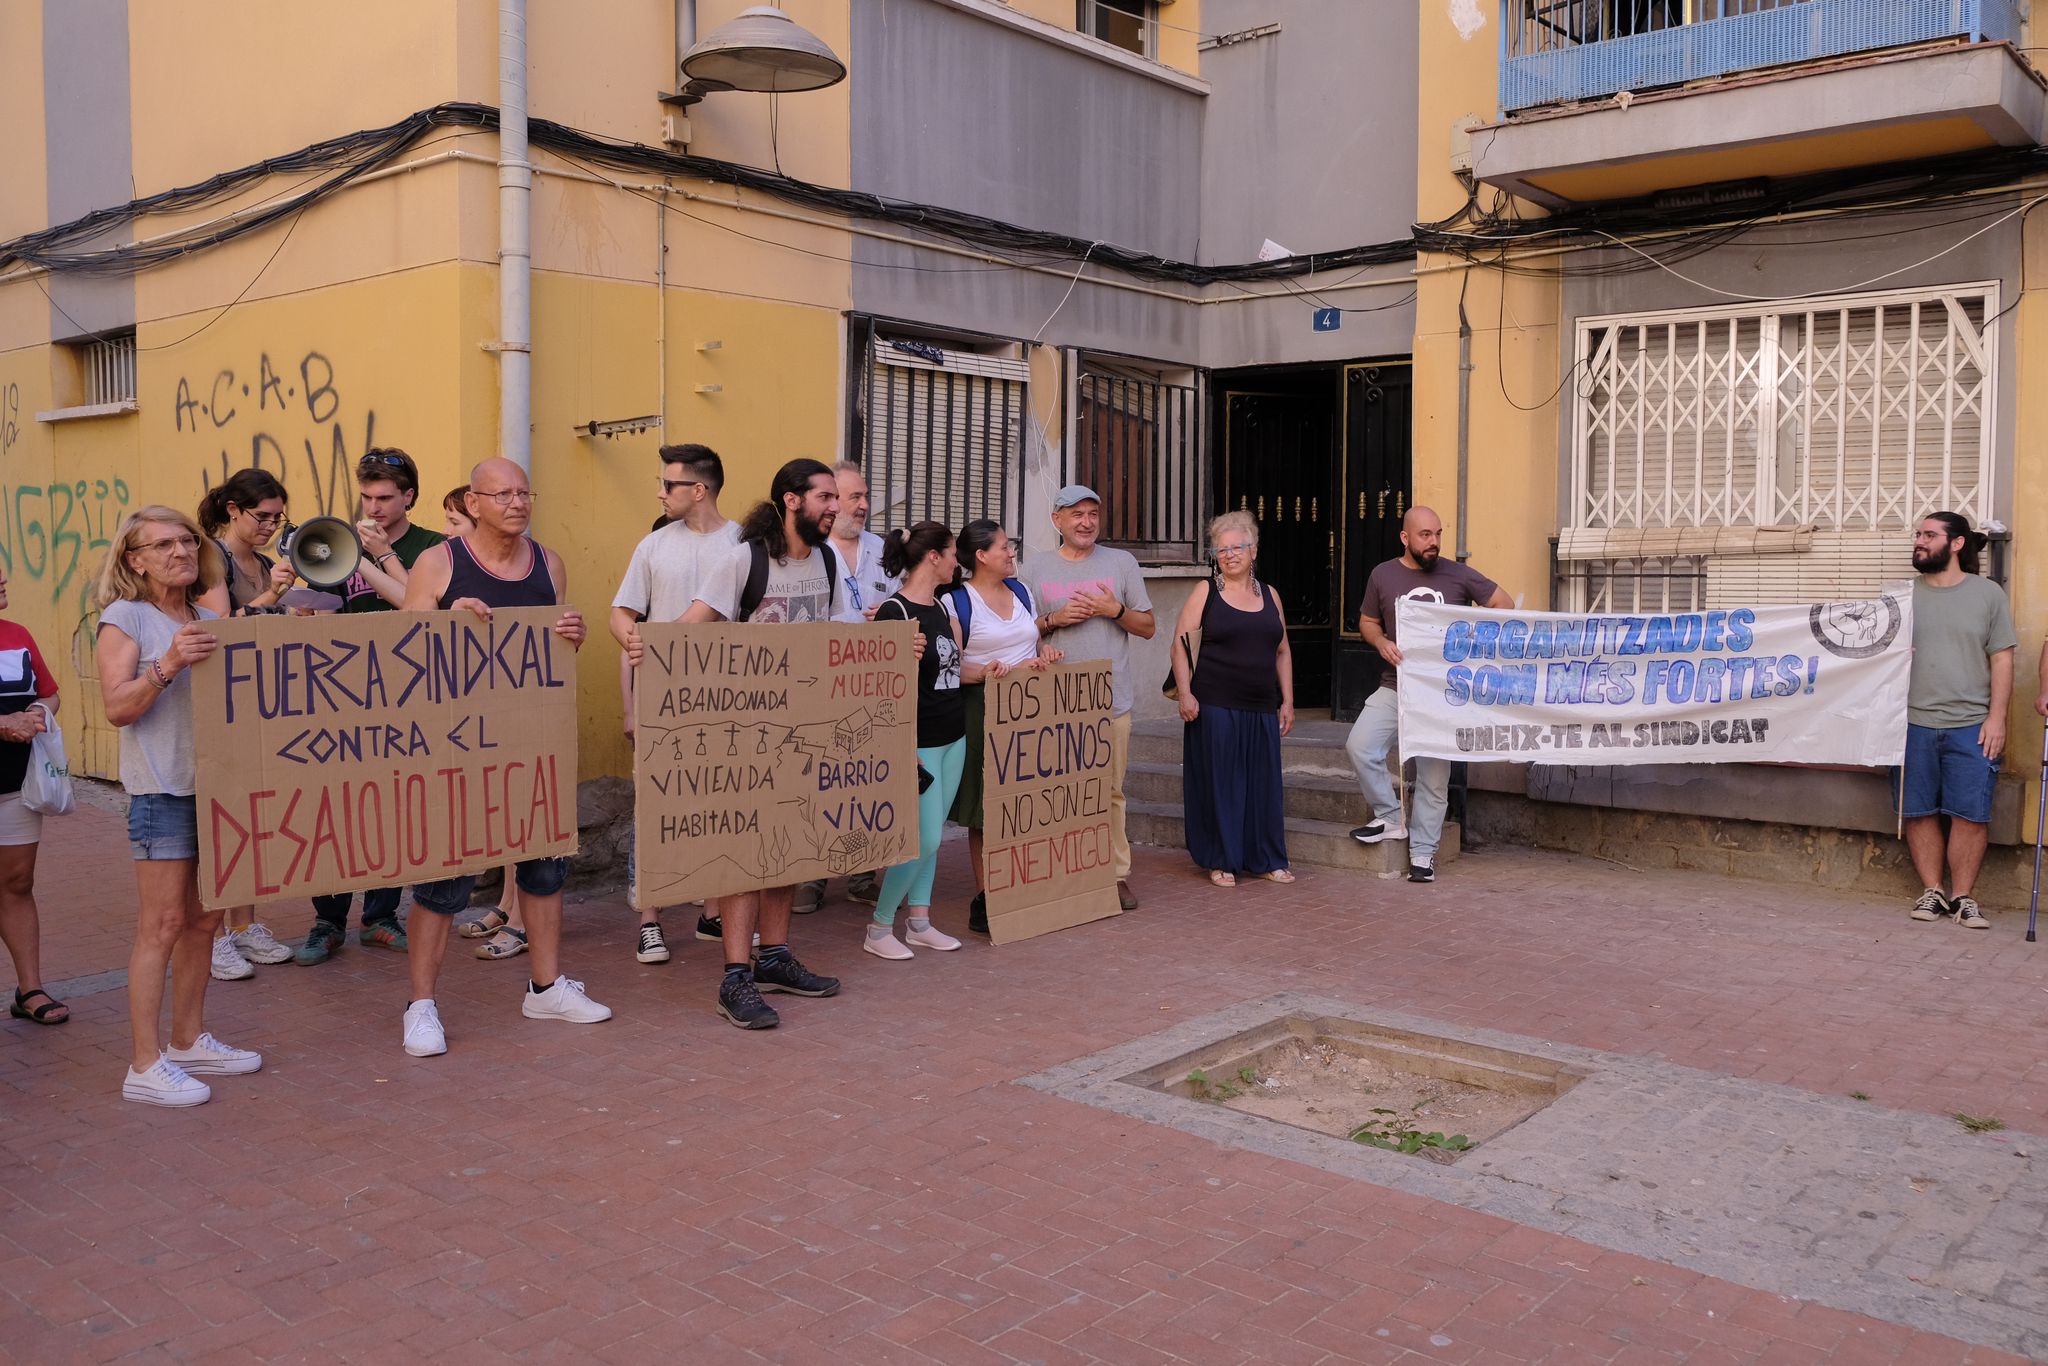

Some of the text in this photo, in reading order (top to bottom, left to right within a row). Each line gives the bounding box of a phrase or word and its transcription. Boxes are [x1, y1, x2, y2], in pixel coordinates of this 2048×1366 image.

[1322, 311, 1331, 328] 4
[767, 583, 791, 594] AME
[828, 635, 897, 668] BARRIO
[1443, 608, 1756, 663] ORGANITZADES
[224, 616, 565, 724] FUERZA SINDICAL
[650, 635, 790, 677] VIVIENDA
[831, 671, 907, 700] MUERTO
[996, 671, 1113, 725] LOS NUEVOS
[1444, 654, 1820, 707] SOM MÉS FORTES!
[659, 687, 788, 718] ABANDONADA
[276, 715, 499, 764] CONTRA EL
[988, 717, 1112, 786] VECINOS
[1455, 718, 1769, 752] UNEIX-TE AL SINDICAT
[650, 760, 775, 796] VIVIENDA
[818, 754, 890, 791] BARRIO
[210, 754, 571, 898] DESALOJO ILEGAL
[661, 809, 760, 844] HABITADA
[823, 796, 895, 833] VIVO
[1001, 777, 1108, 840] NO SON EL
[988, 822, 1112, 894] ENEMIGO
